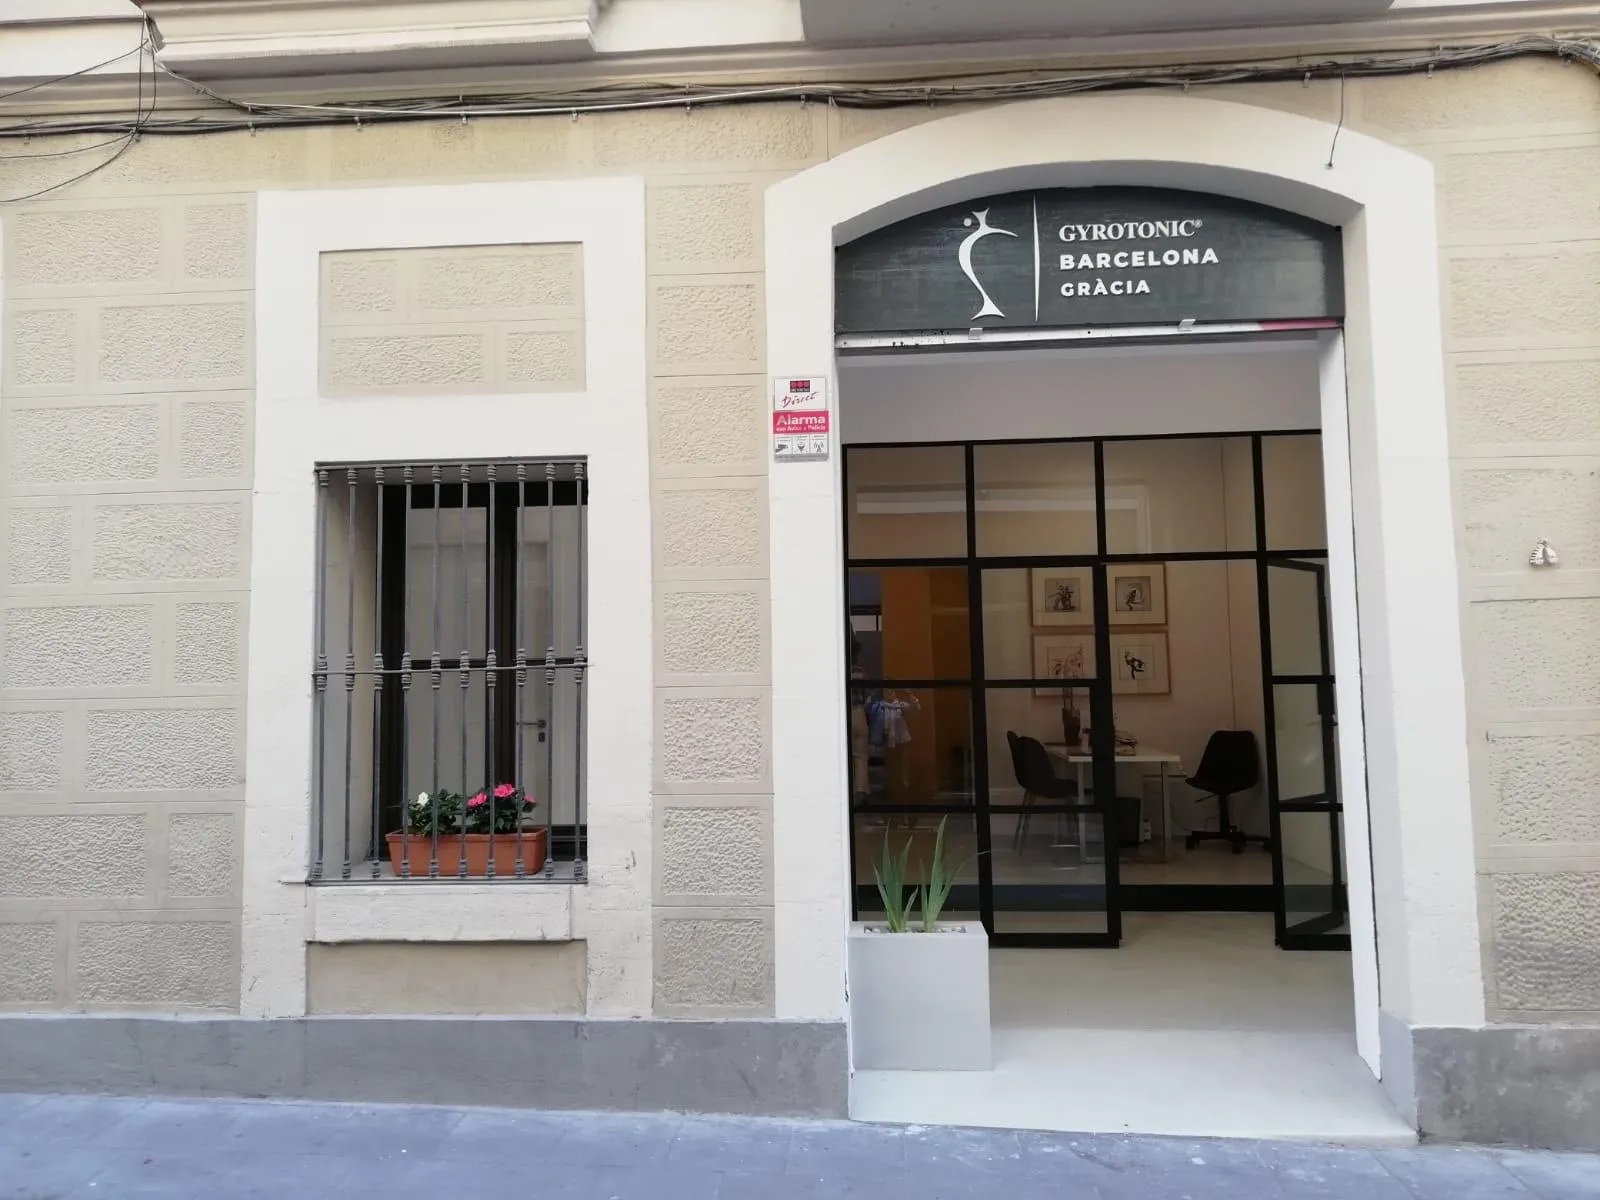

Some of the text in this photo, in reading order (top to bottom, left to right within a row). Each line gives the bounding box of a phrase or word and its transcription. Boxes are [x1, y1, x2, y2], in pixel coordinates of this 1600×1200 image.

[1059, 248, 1219, 270] BARCELONA
[1060, 278, 1151, 297] GRÀCIA
[776, 413, 826, 425] Alarma
